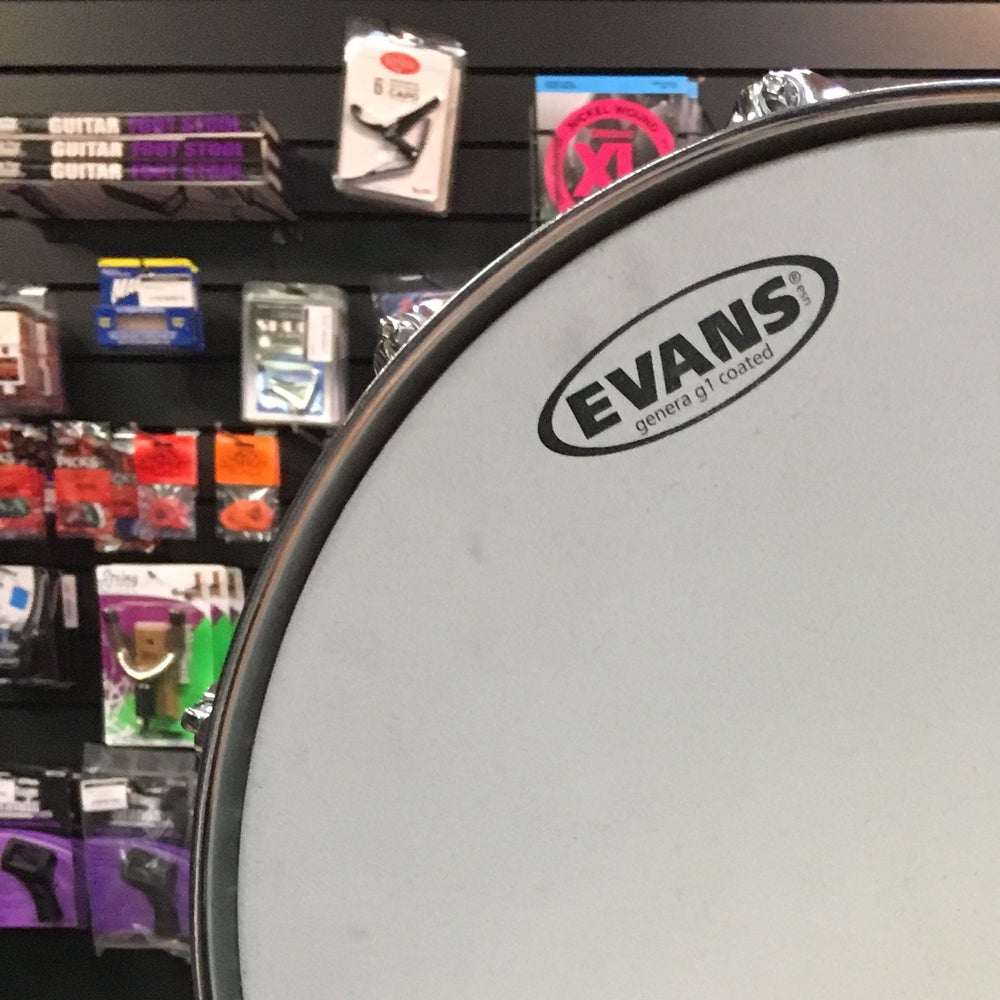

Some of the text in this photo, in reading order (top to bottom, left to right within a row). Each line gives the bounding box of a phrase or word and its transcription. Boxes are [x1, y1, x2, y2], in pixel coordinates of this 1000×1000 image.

[49, 117, 120, 134] GUITAR
[51, 141, 123, 158] GUITAR
[51, 162, 122, 180] GUITAR
[565, 275, 800, 440] EVANS
[635, 343, 774, 435] genera g1 coated
